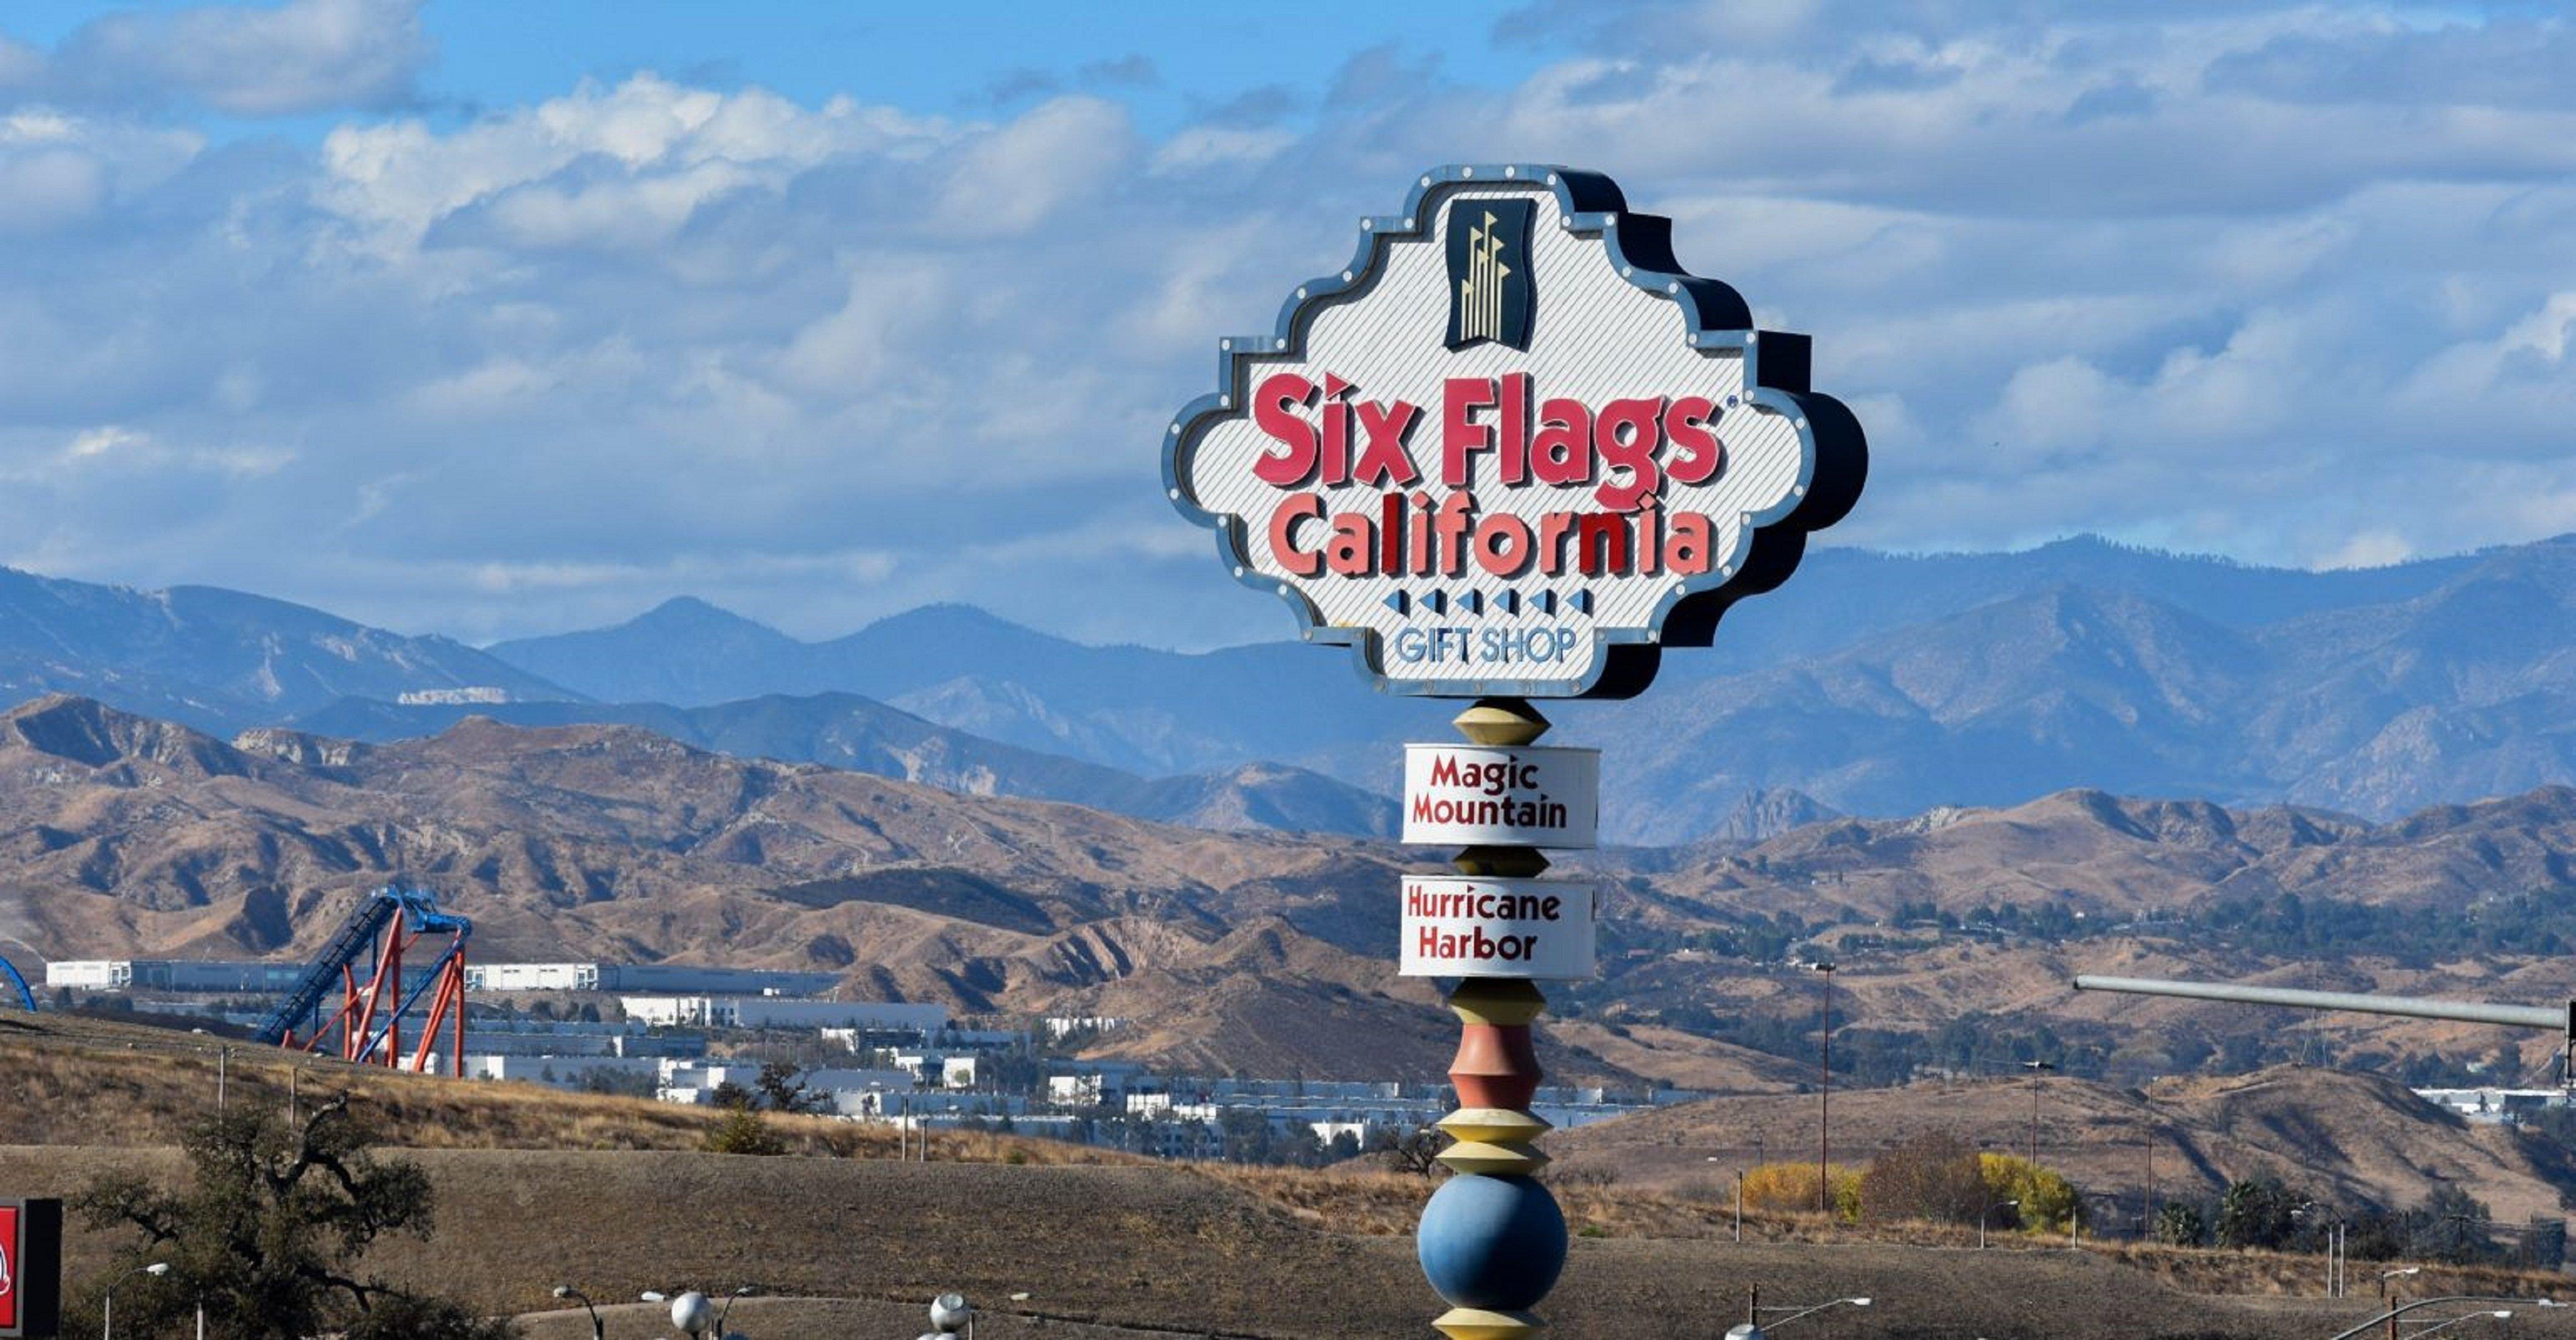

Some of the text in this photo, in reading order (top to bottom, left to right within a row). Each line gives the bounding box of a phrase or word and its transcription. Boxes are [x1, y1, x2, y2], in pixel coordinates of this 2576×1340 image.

[1252, 372, 1720, 512] Six Flags
[1268, 491, 1718, 576] California
[1396, 626, 1576, 663] GIFT SHOP
[1430, 753, 1539, 795] Magic
[1413, 792, 1566, 828] Mountain
[1408, 884, 1561, 921] Hurricane
[1420, 926, 1538, 961] Harbor
